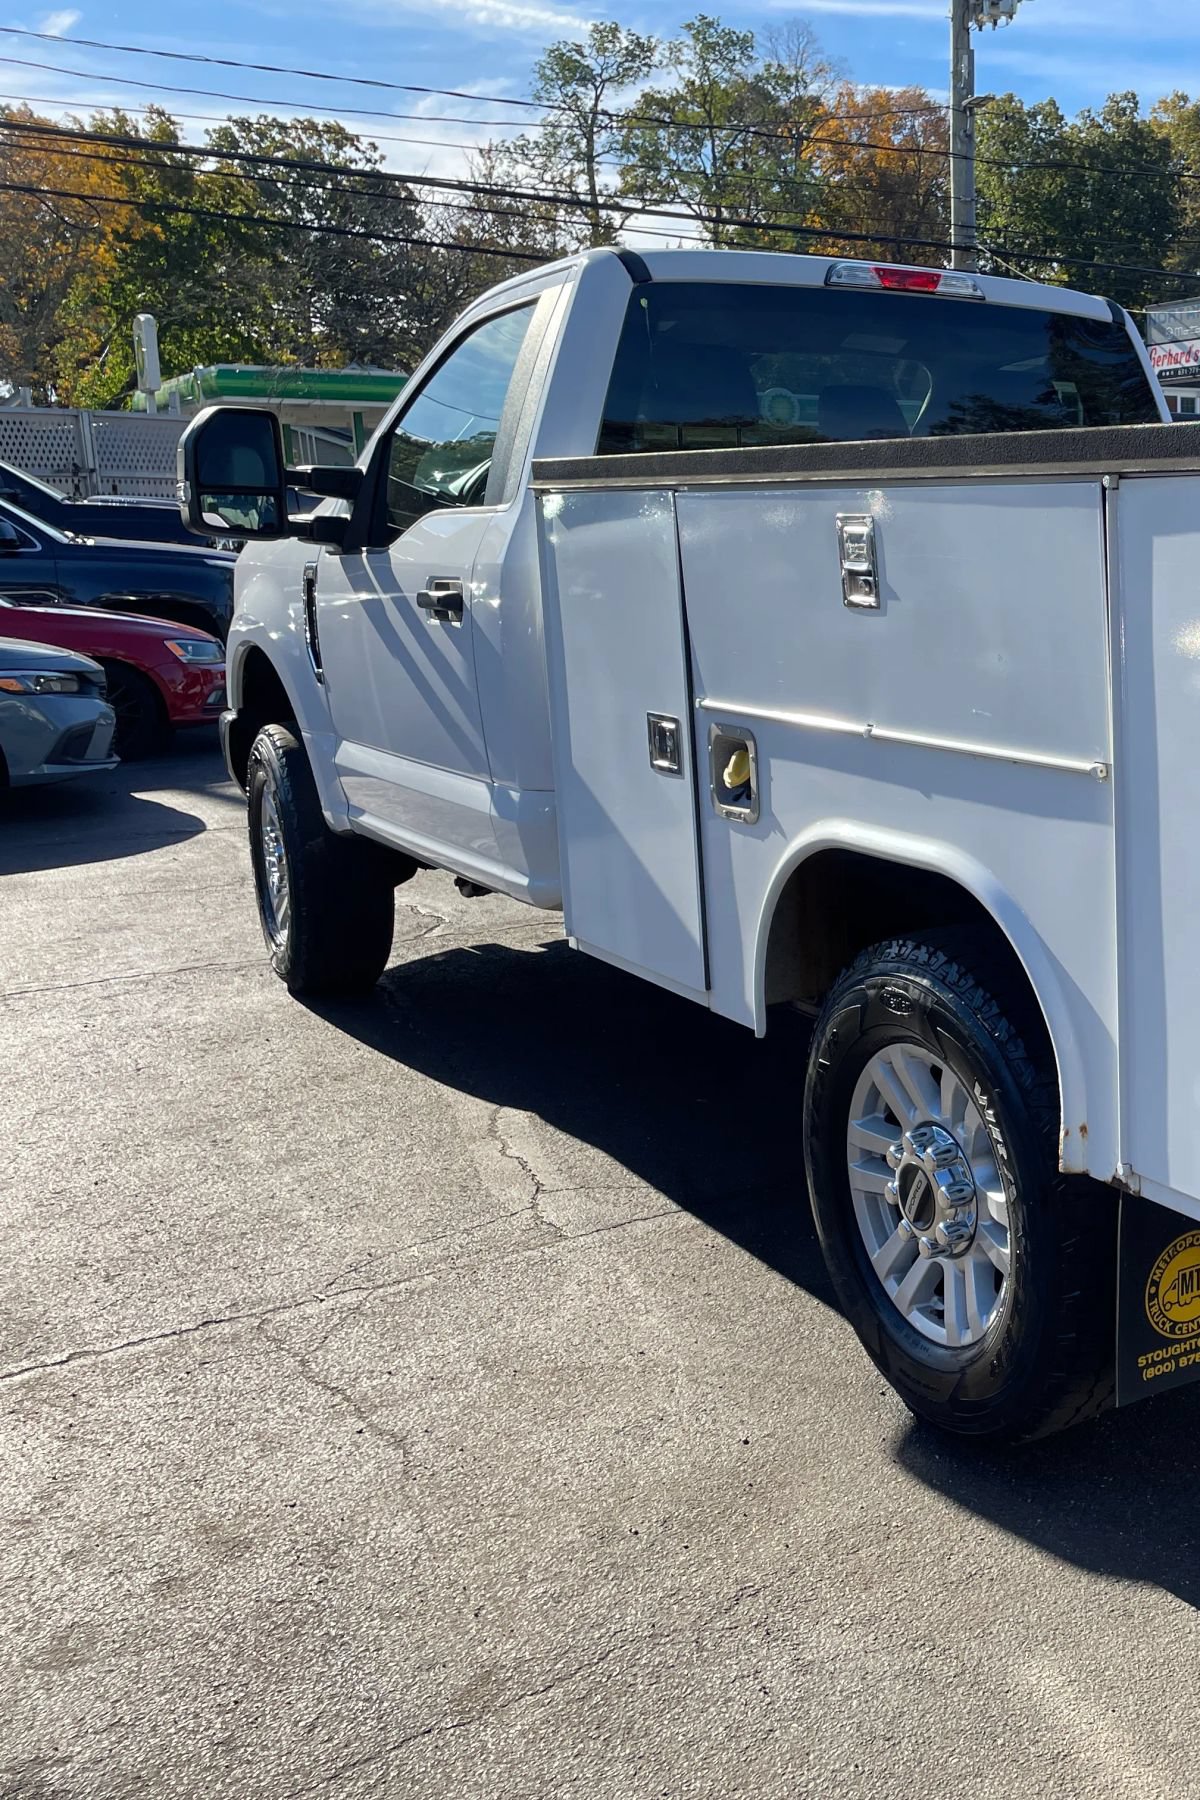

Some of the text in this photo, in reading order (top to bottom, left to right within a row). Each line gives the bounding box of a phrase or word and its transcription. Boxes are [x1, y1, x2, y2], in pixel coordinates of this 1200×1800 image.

[1150, 344, 1200, 368] Gerhard's
[1147, 1297, 1172, 1332] TRUCK
[1141, 1359, 1176, 1382] (800)
